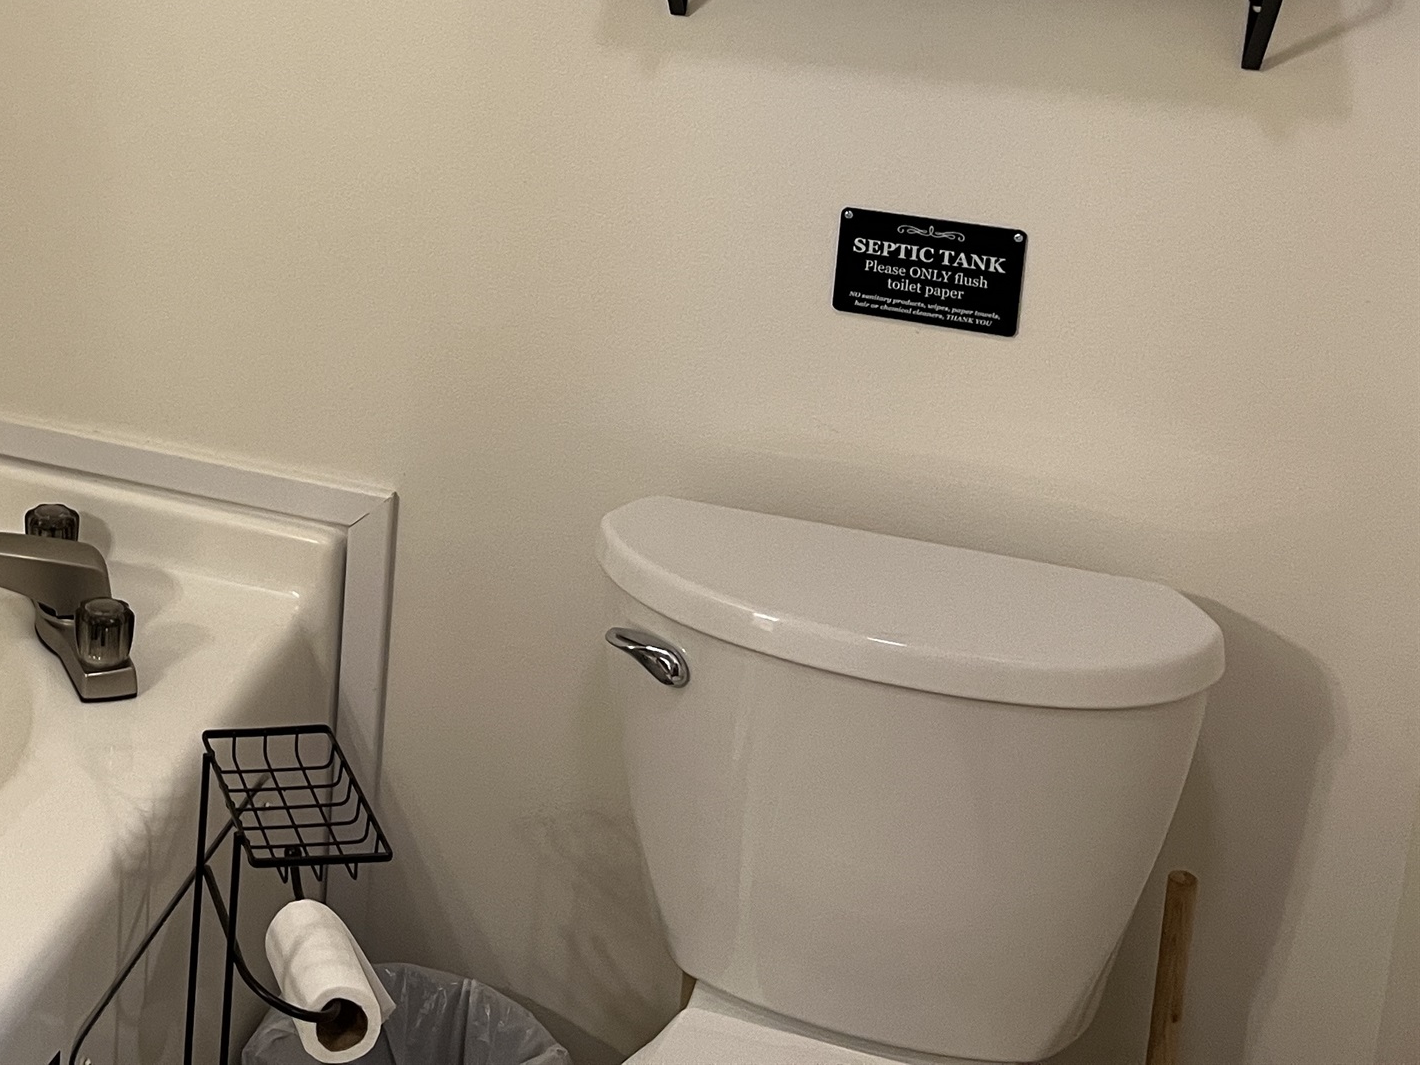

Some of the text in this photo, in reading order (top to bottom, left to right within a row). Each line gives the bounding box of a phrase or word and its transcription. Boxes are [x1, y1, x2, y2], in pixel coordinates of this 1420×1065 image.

[852, 237, 1007, 274] SEPTIC TANK
[864, 259, 989, 289] Please ONLY flush
[887, 278, 965, 300] toilet paper
[848, 290, 861, 298] NO
[861, 293, 892, 304] sanitary
[892, 297, 927, 309] products,
[927, 303, 951, 312] wipes,
[951, 307, 974, 317] paper
[854, 299, 870, 308] hair
[880, 303, 912, 315] chemical
[946, 314, 974, 324] THANK
[975, 318, 993, 327] YOU
